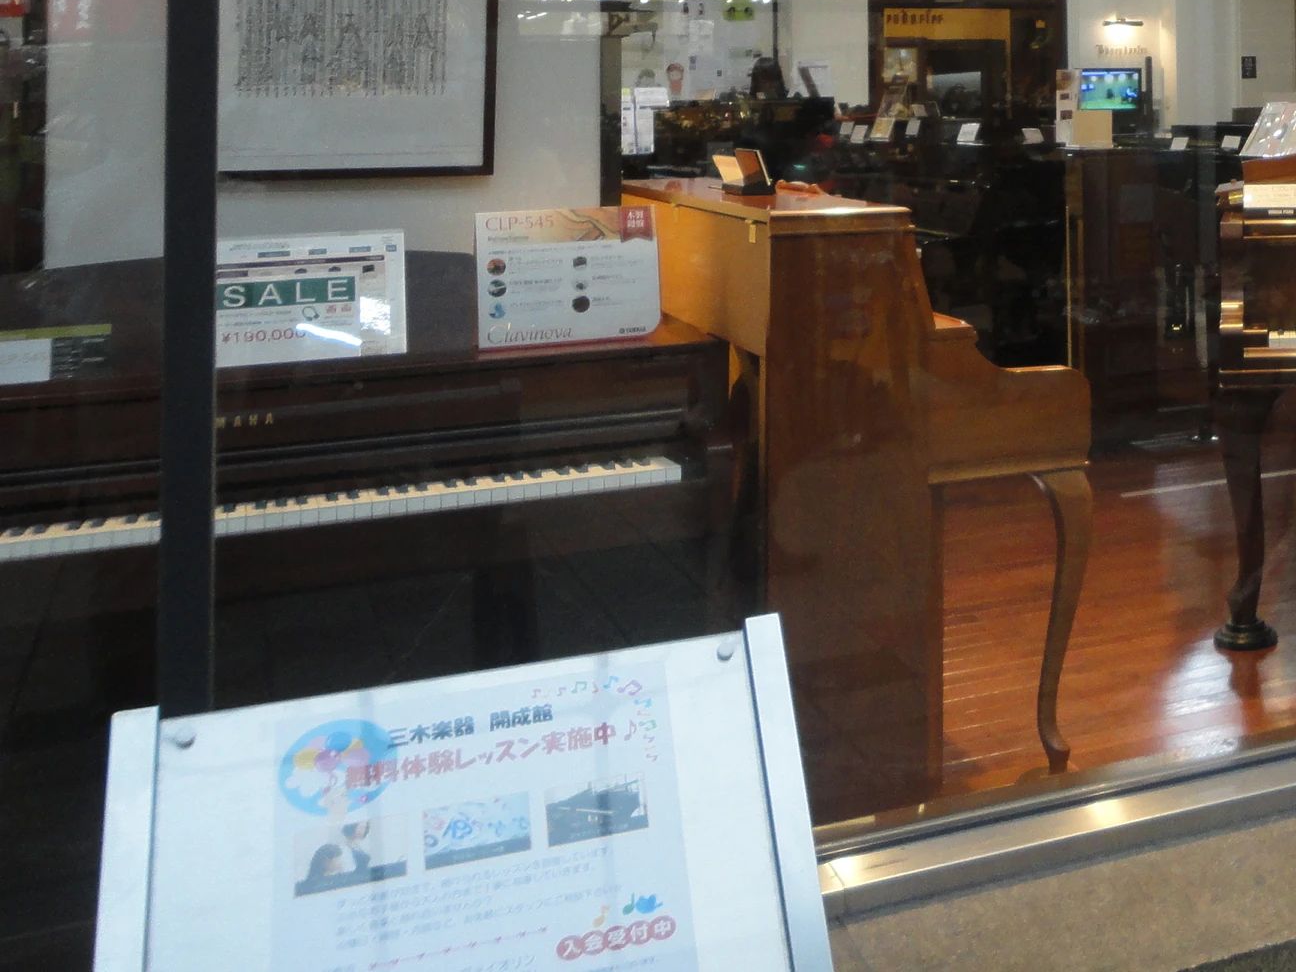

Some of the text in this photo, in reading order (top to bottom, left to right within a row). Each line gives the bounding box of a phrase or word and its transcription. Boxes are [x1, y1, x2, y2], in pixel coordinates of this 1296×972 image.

[484, 214, 555, 233] CLP-545
[222, 278, 350, 308] SALE
[487, 322, 573, 346] Clavinova
[388, 703, 553, 749] 三木楽器 開成館
[559, 918, 674, 958] 入会受付中
